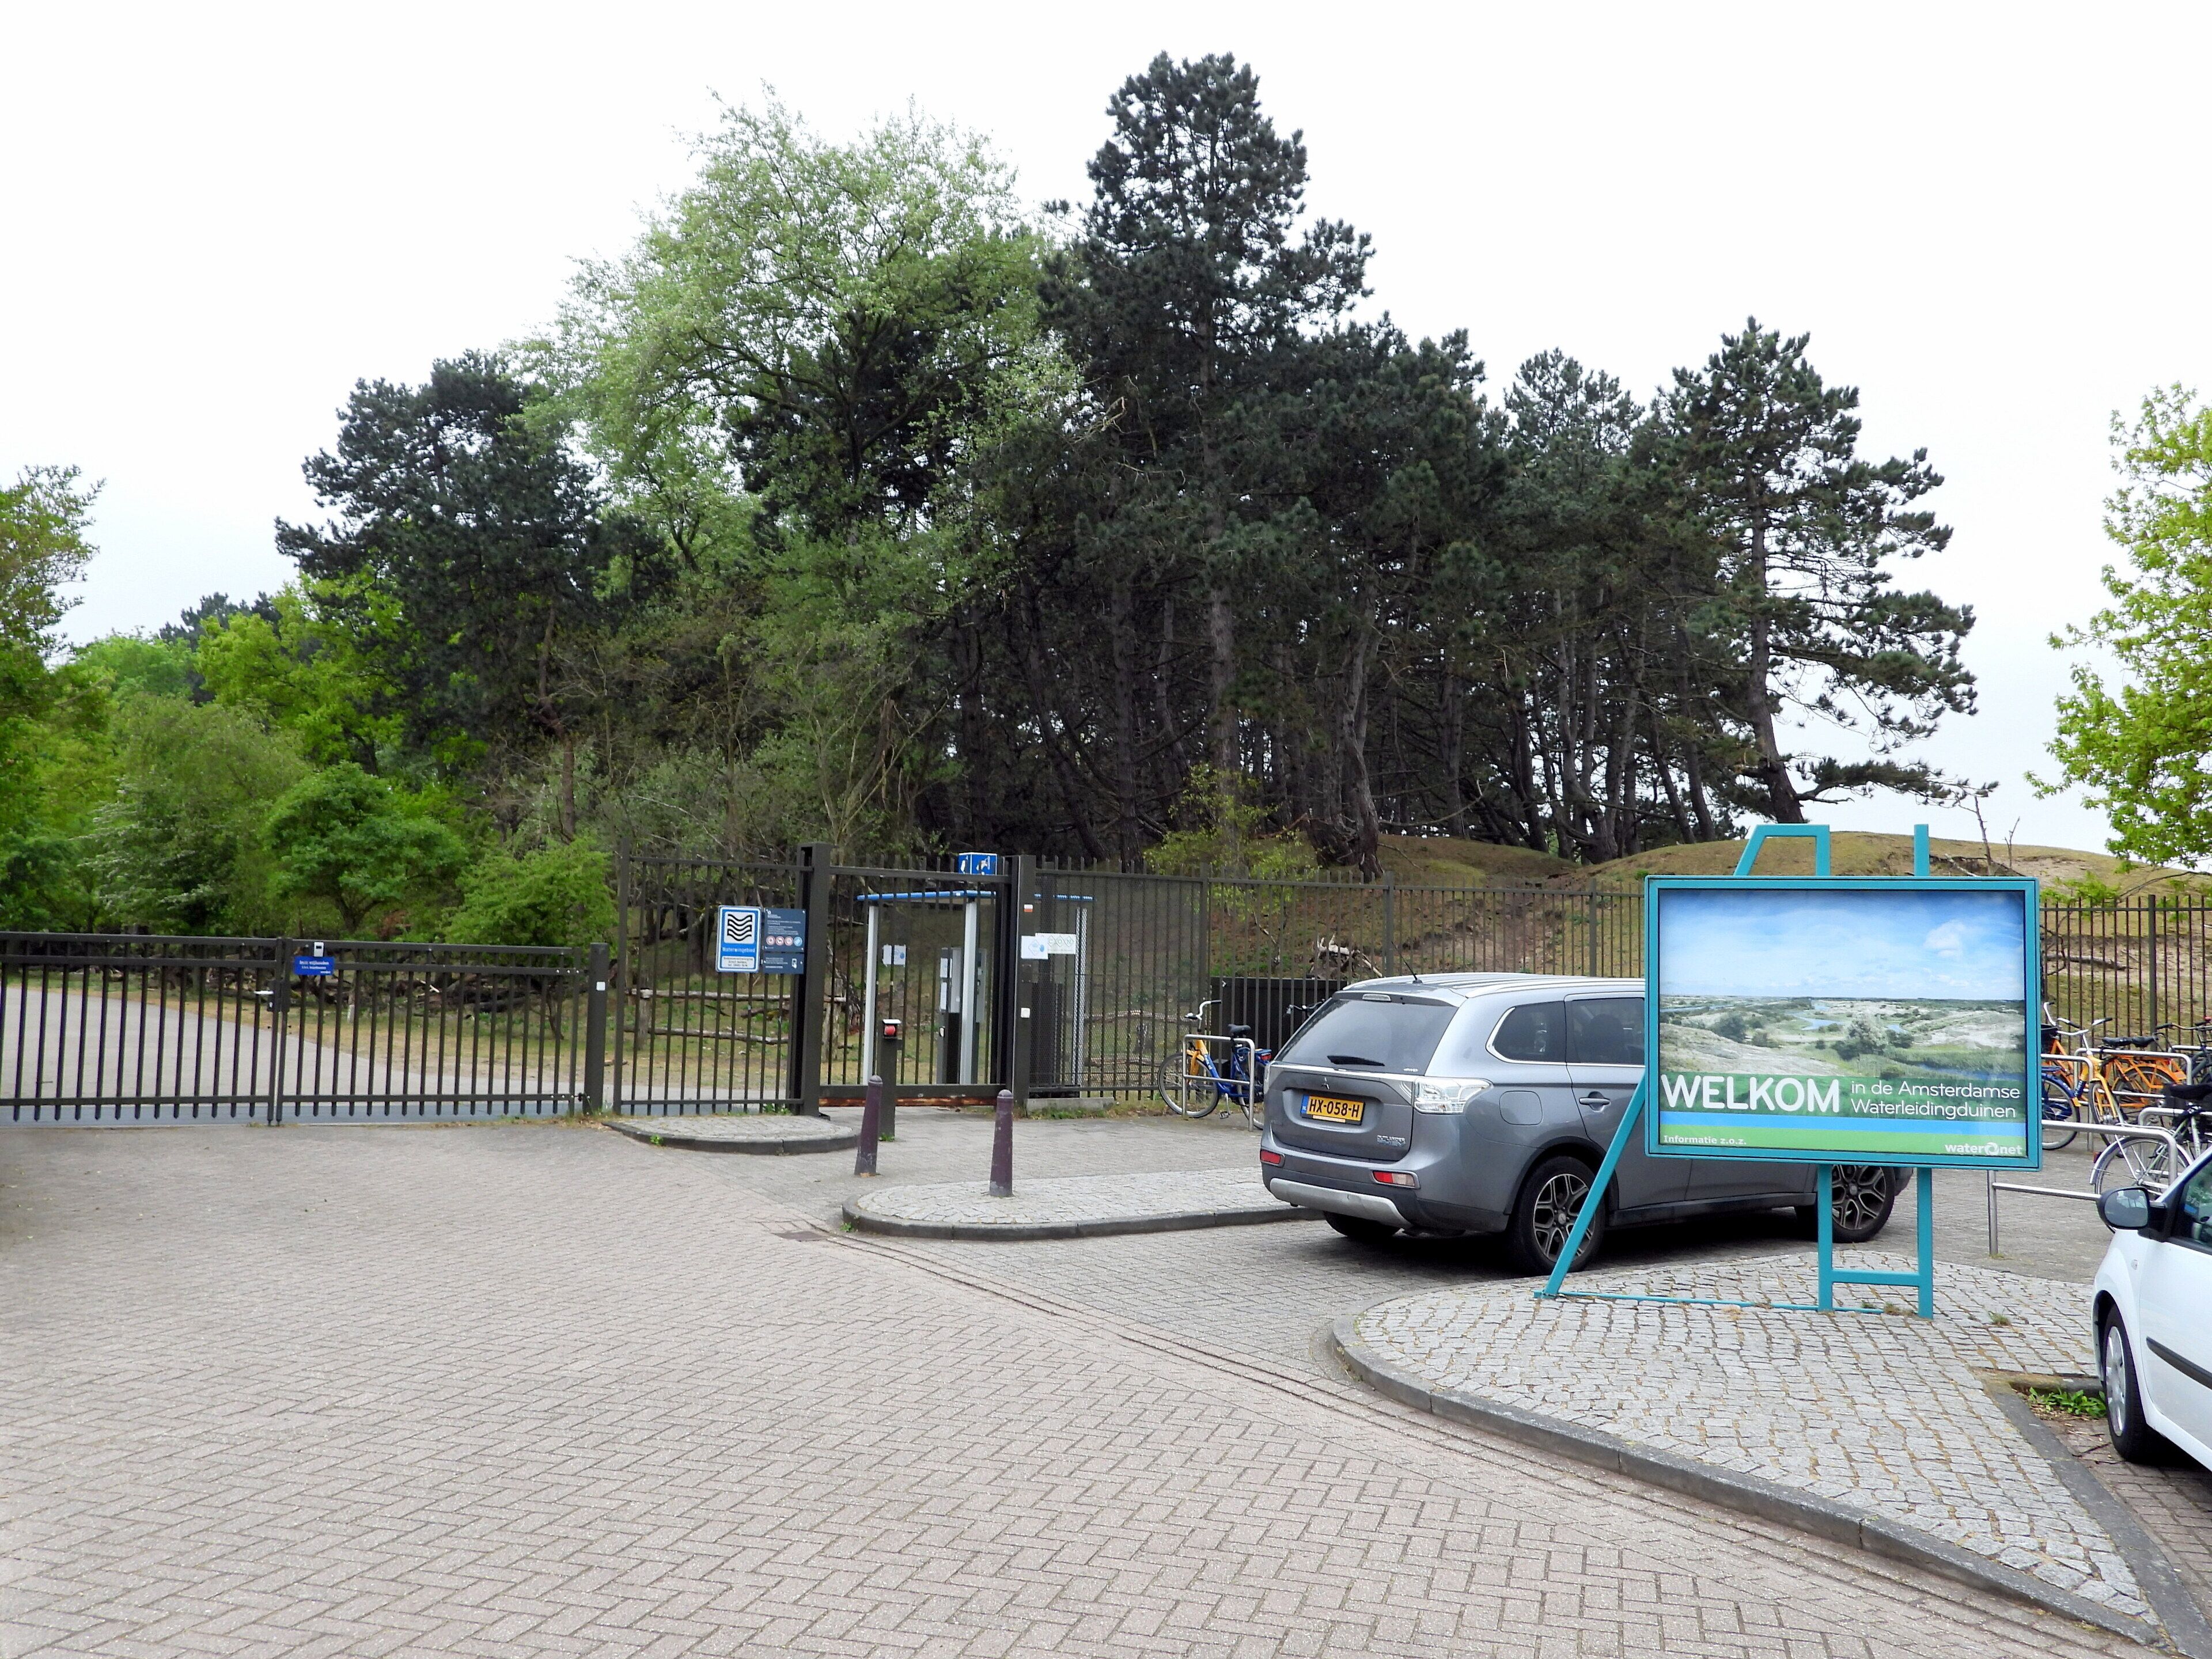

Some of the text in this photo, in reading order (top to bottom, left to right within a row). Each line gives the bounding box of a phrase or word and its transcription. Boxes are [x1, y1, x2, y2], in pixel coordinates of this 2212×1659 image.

[1661, 1074, 2020, 1113] WELKOM in de Amsterdamse
[1309, 1099, 1360, 1118] HX-058-H
[1851, 1098, 2016, 1120] Waterleidingduinen
[1664, 1135, 1717, 1144] Informatie
